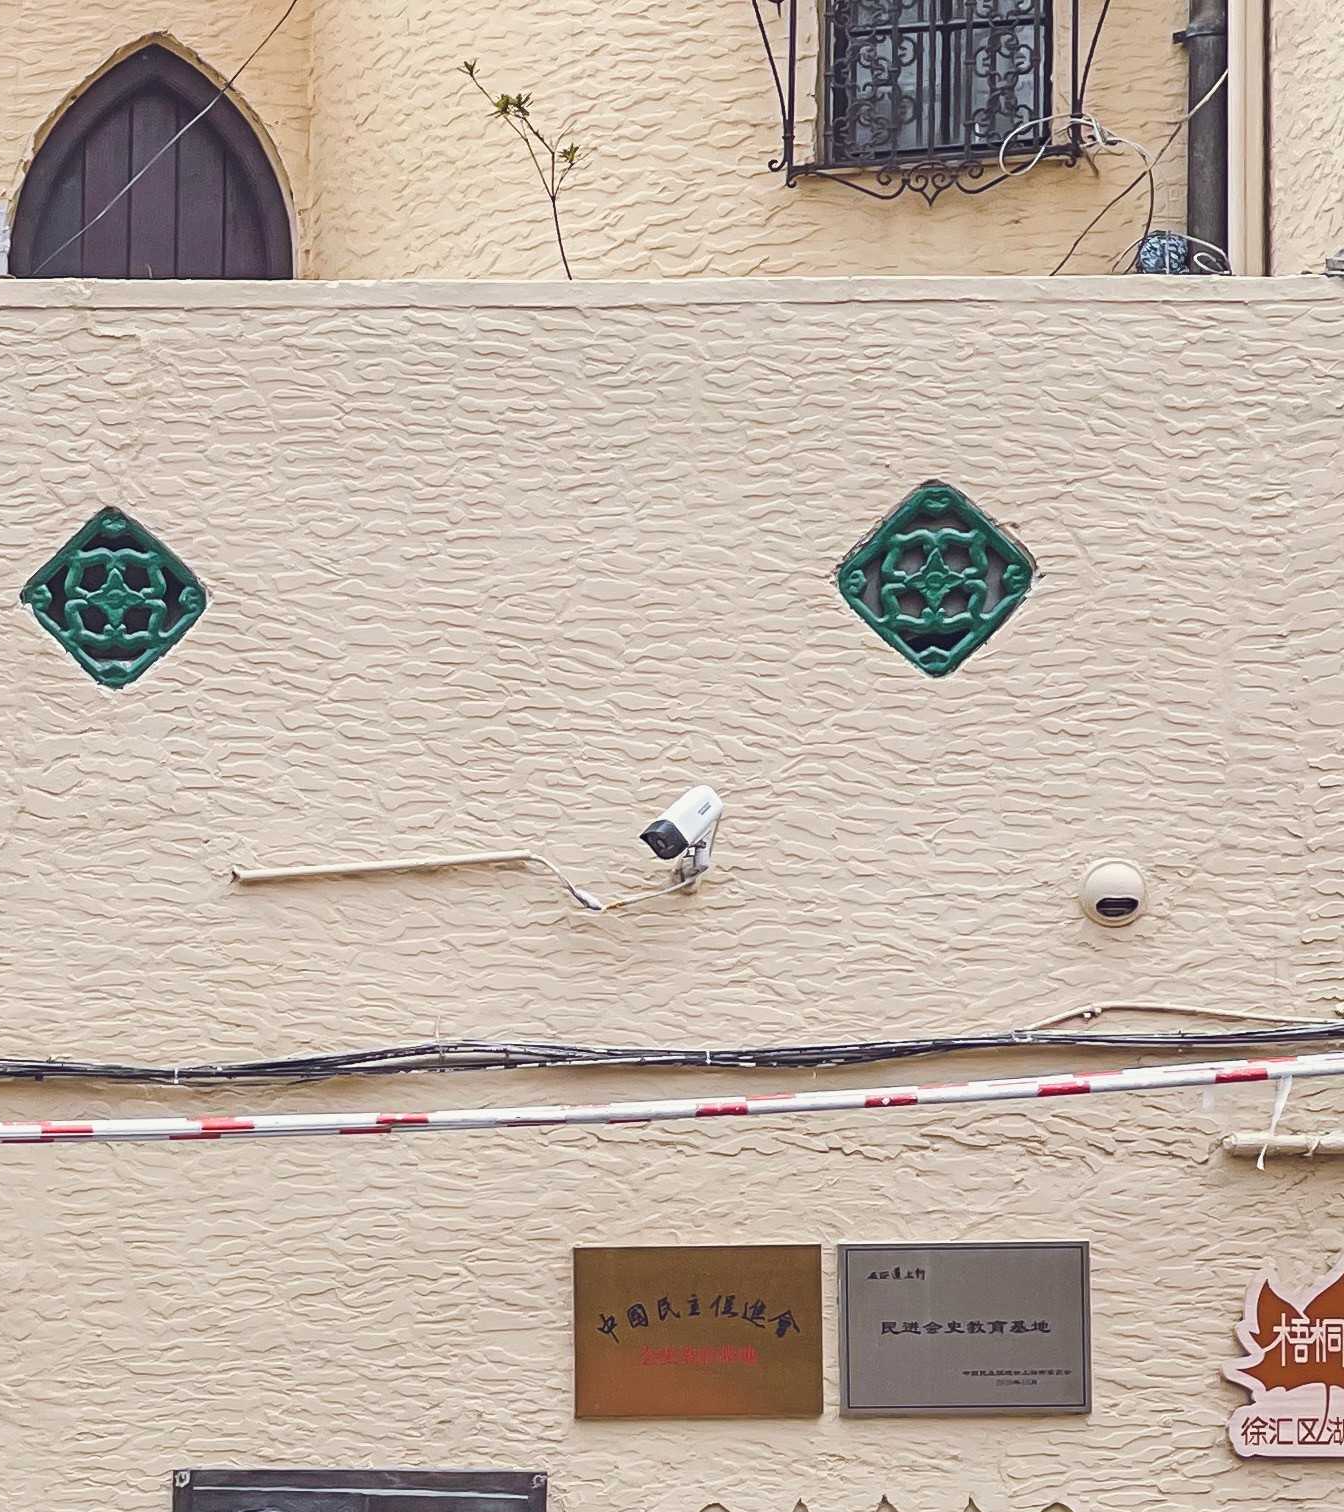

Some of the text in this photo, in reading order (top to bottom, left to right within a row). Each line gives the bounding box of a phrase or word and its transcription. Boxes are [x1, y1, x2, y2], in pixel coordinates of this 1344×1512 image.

[880, 1319, 1052, 1336] 民进会史教育基地
[1272, 1313, 1344, 1367] 梧桐
